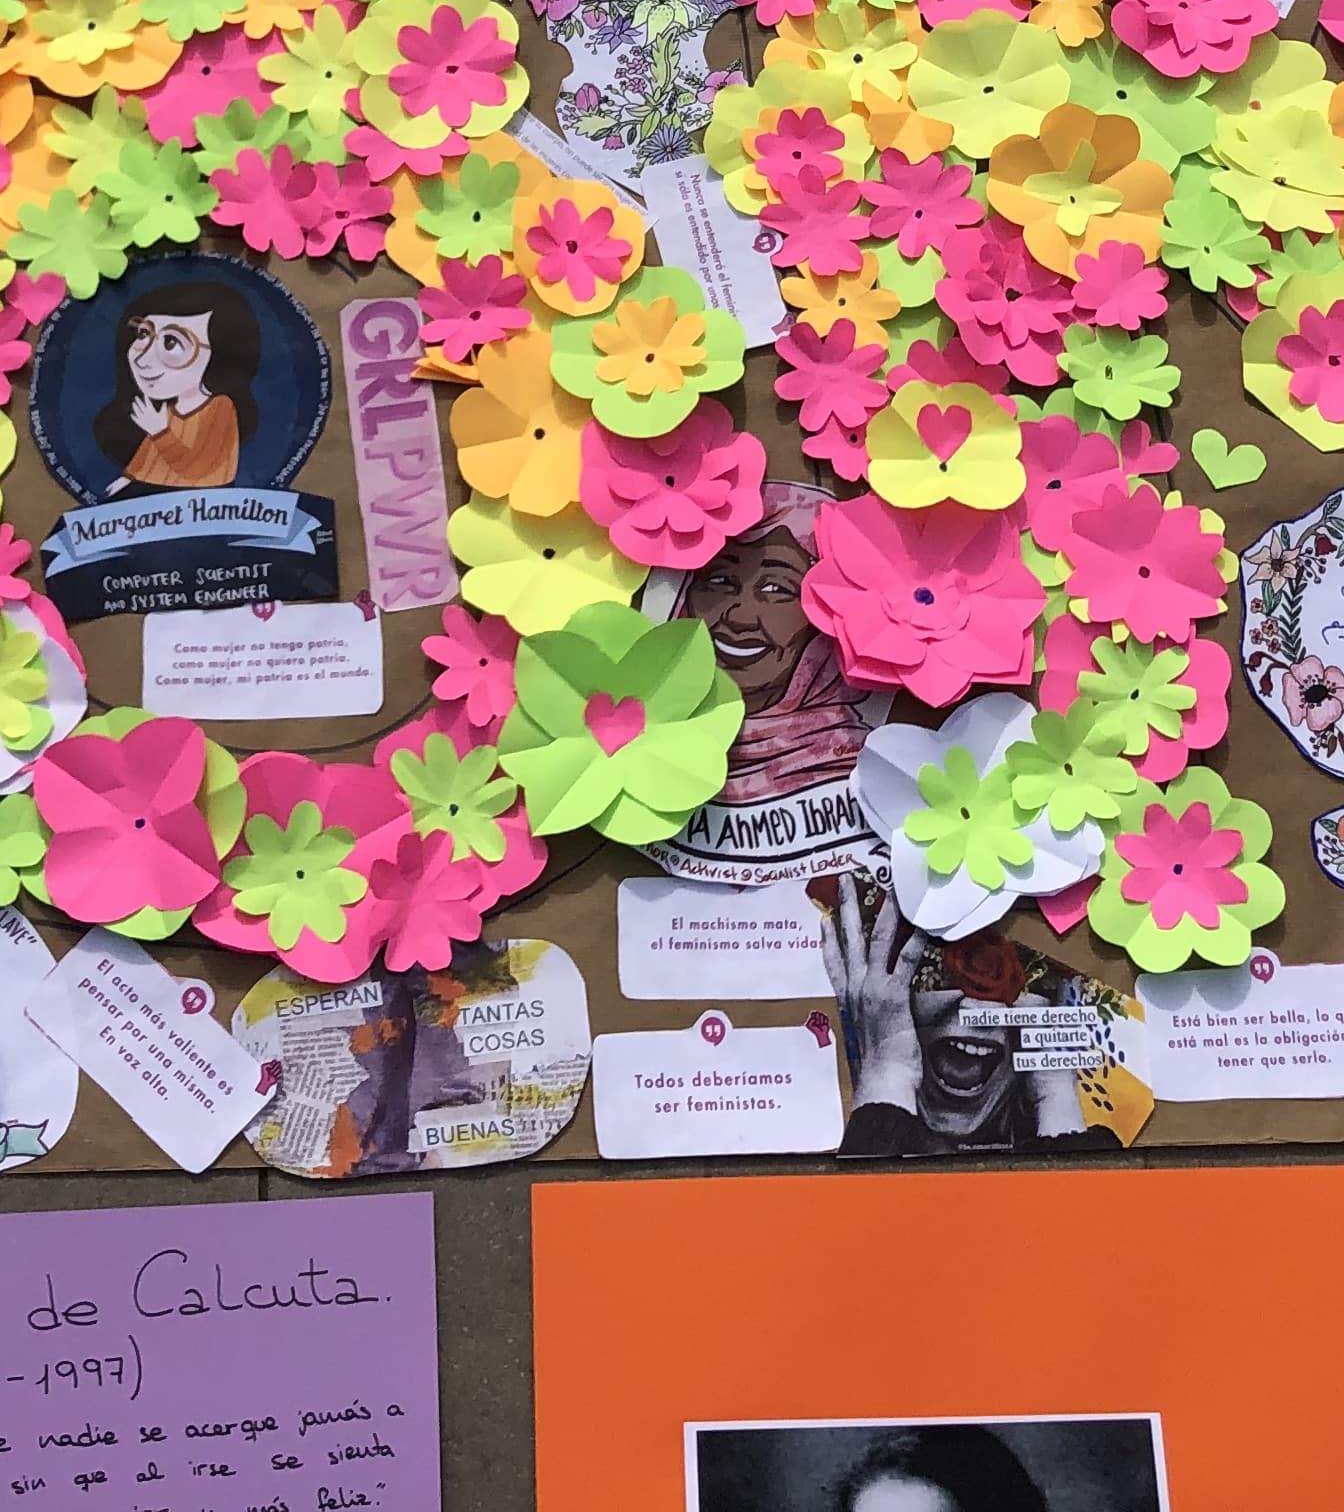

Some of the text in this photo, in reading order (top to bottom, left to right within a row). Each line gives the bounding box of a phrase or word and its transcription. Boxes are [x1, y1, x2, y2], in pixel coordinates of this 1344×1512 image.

[346, 301, 442, 609] GRLPWR
[71, 498, 288, 545] Margaret Hamilton
[103, 563, 272, 592] COMPUTER SCIENTIST
[104, 584, 269, 612] AND SYSTEM ENGINEER
[277, 987, 379, 1017] ESPERAN
[460, 1001, 545, 1025] TANTAS
[962, 1008, 1096, 1026] nadie tiene derecho
[470, 1029, 544, 1053] COSAS
[1022, 1029, 1087, 1045] a quitarte
[1016, 1052, 1103, 1068] tus derechos
[635, 1071, 791, 1088] Todos deberíamos
[655, 1096, 781, 1113] ser feministas.
[426, 1118, 515, 1146] BUENAS
[27, 1275, 99, 1331] de
[133, 1250, 392, 1318] Calcuta.
